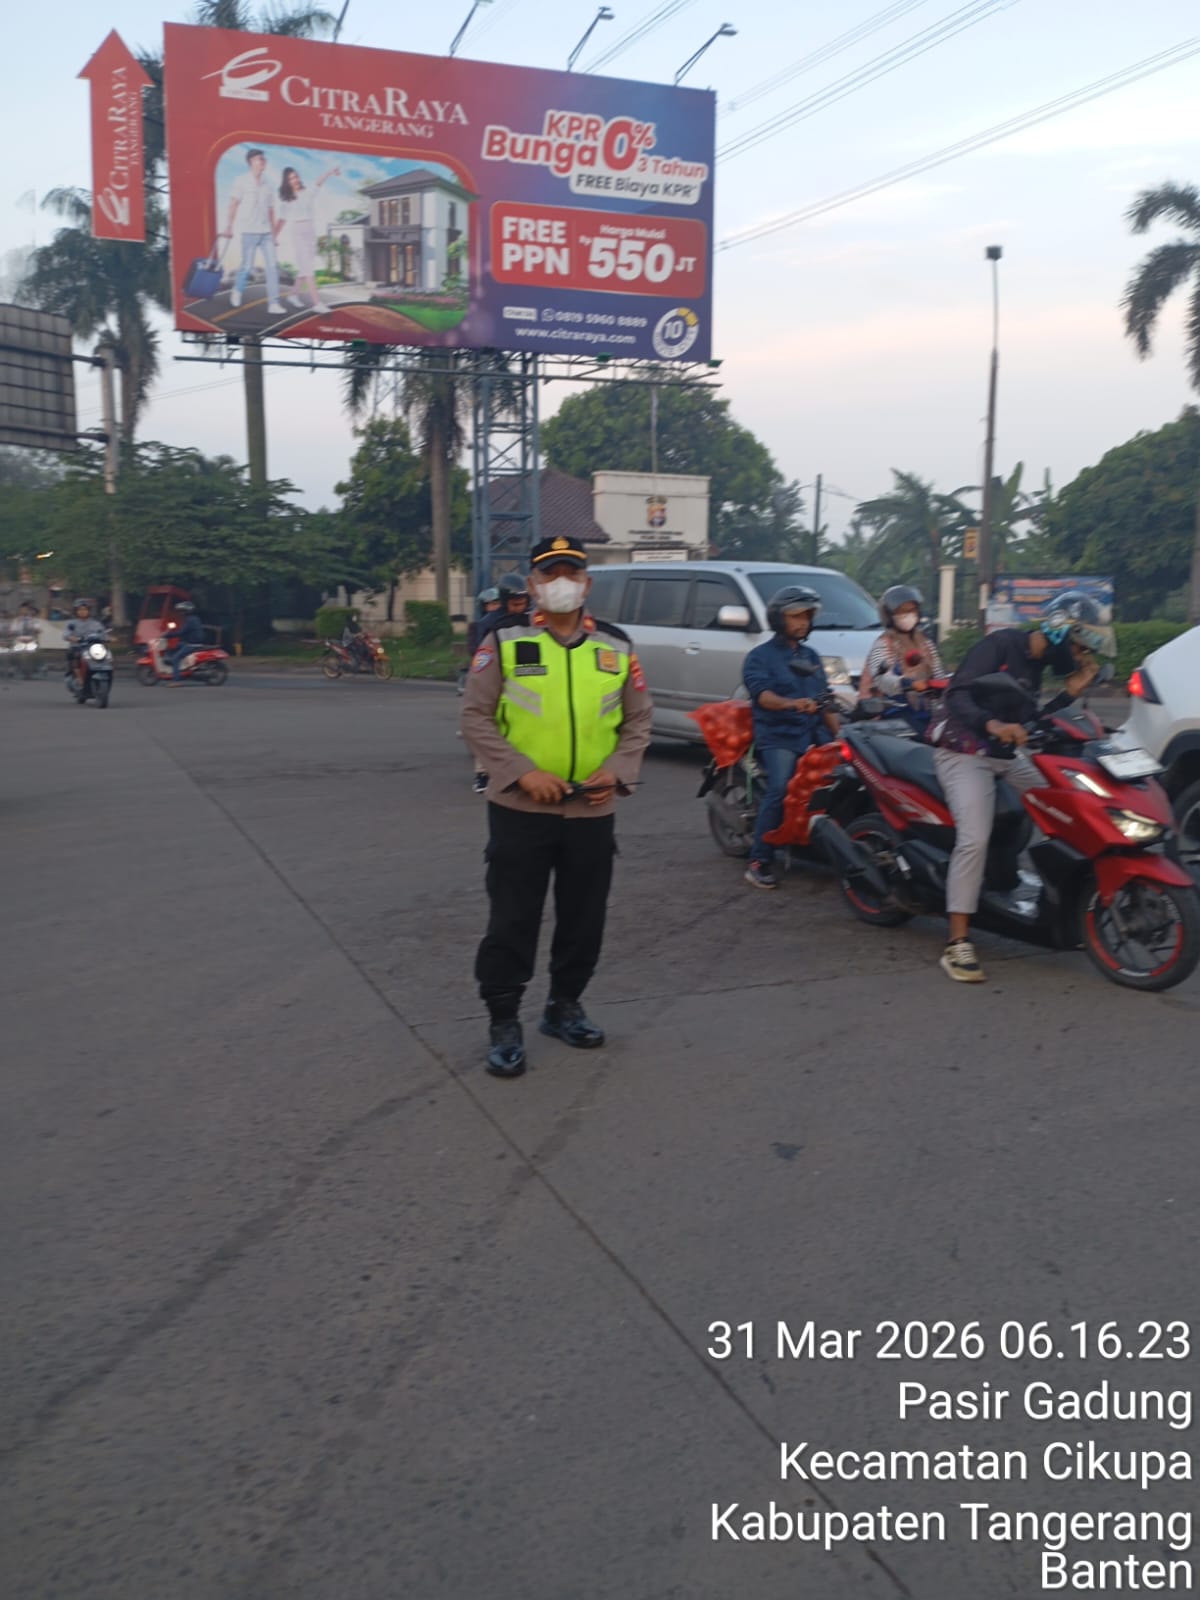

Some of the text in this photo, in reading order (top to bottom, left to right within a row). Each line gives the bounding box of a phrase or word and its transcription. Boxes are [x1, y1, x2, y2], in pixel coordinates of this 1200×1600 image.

[320, 112, 434, 139] TANGERANG
[546, 112, 602, 142] KPR
[484, 128, 598, 175] Bunga
[637, 156, 705, 179] 3 Tahun
[576, 173, 613, 190] FREE
[615, 177, 660, 197] Biaya
[502, 216, 567, 245] FREE
[599, 224, 634, 239] Harga
[502, 243, 570, 275] PPN
[587, 236, 675, 283] 550
[674, 256, 697, 272] JT
[514, 326, 636, 344] www.citraraya.com
[664, 320, 684, 340] 10
